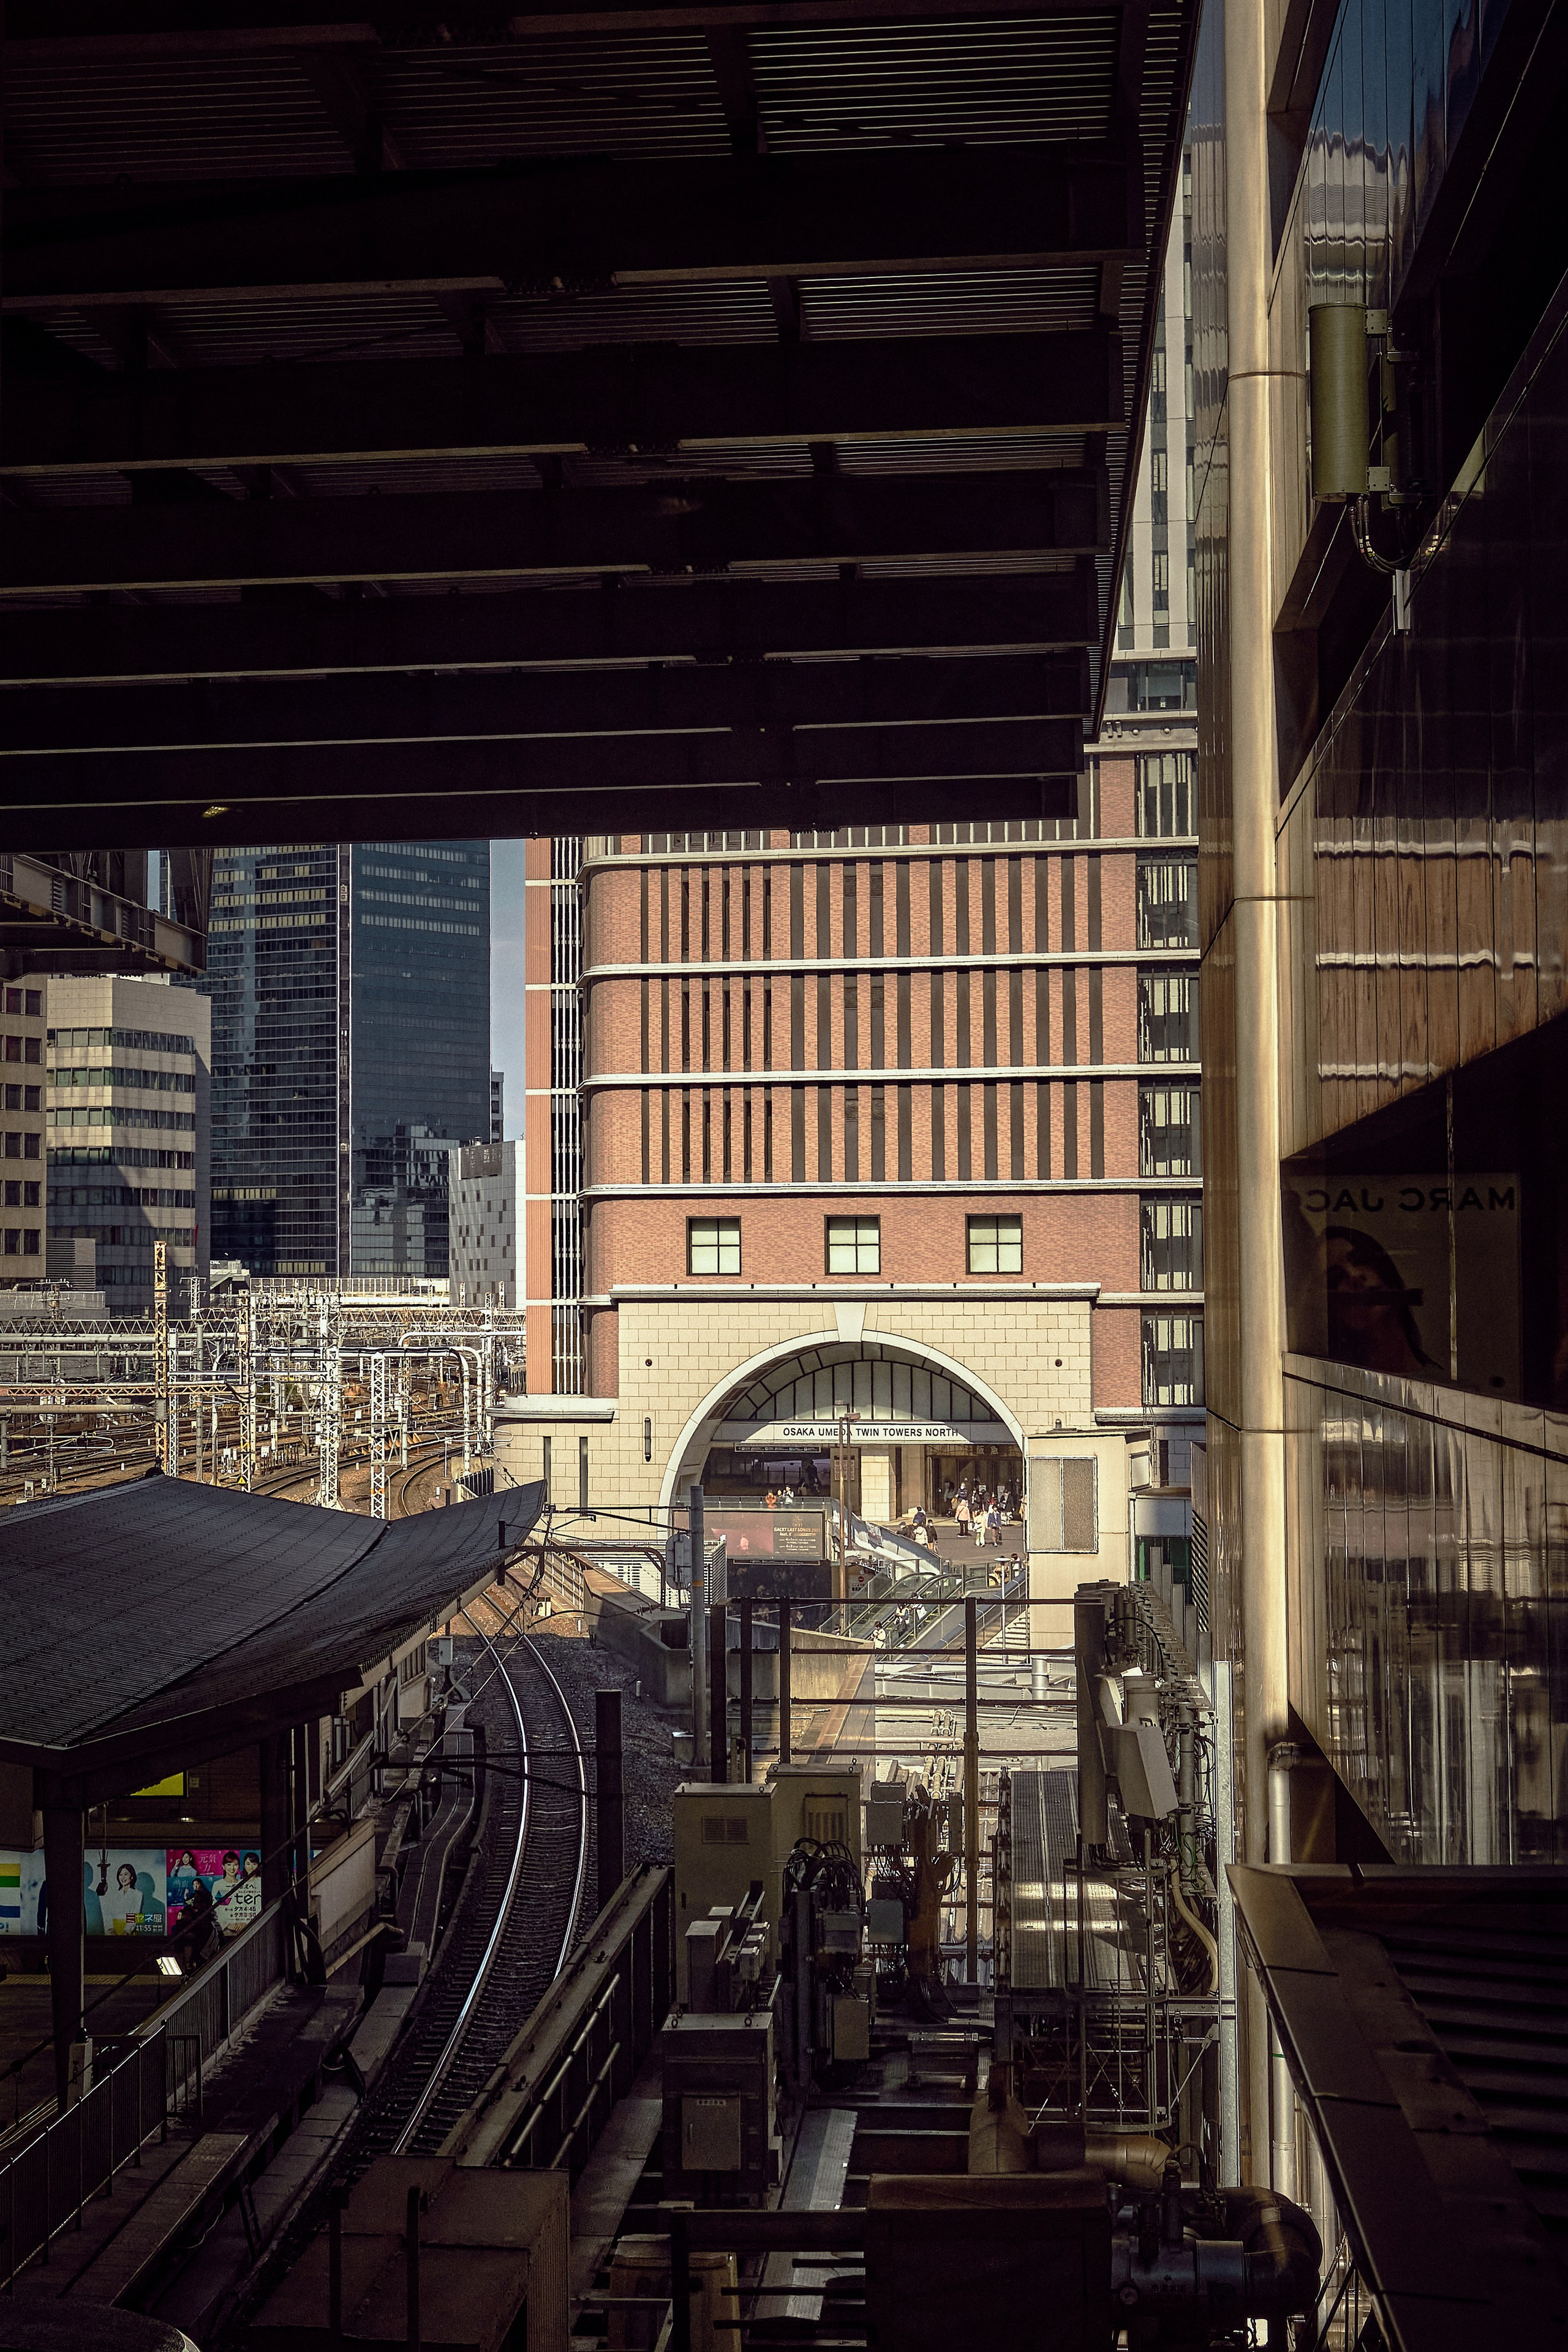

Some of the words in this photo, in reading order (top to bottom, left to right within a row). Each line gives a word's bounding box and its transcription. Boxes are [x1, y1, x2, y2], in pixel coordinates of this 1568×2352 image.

[783, 1428, 815, 1436] OSAKA
[818, 1428, 853, 1437] UMEDA
[856, 1428, 880, 1437] TWIN
[883, 1428, 922, 1437] TOWERS
[925, 1428, 958, 1437] NORTH
[976, 1445, 999, 1455] 阪急
[126, 1913, 162, 1923] ミヤネ屋
